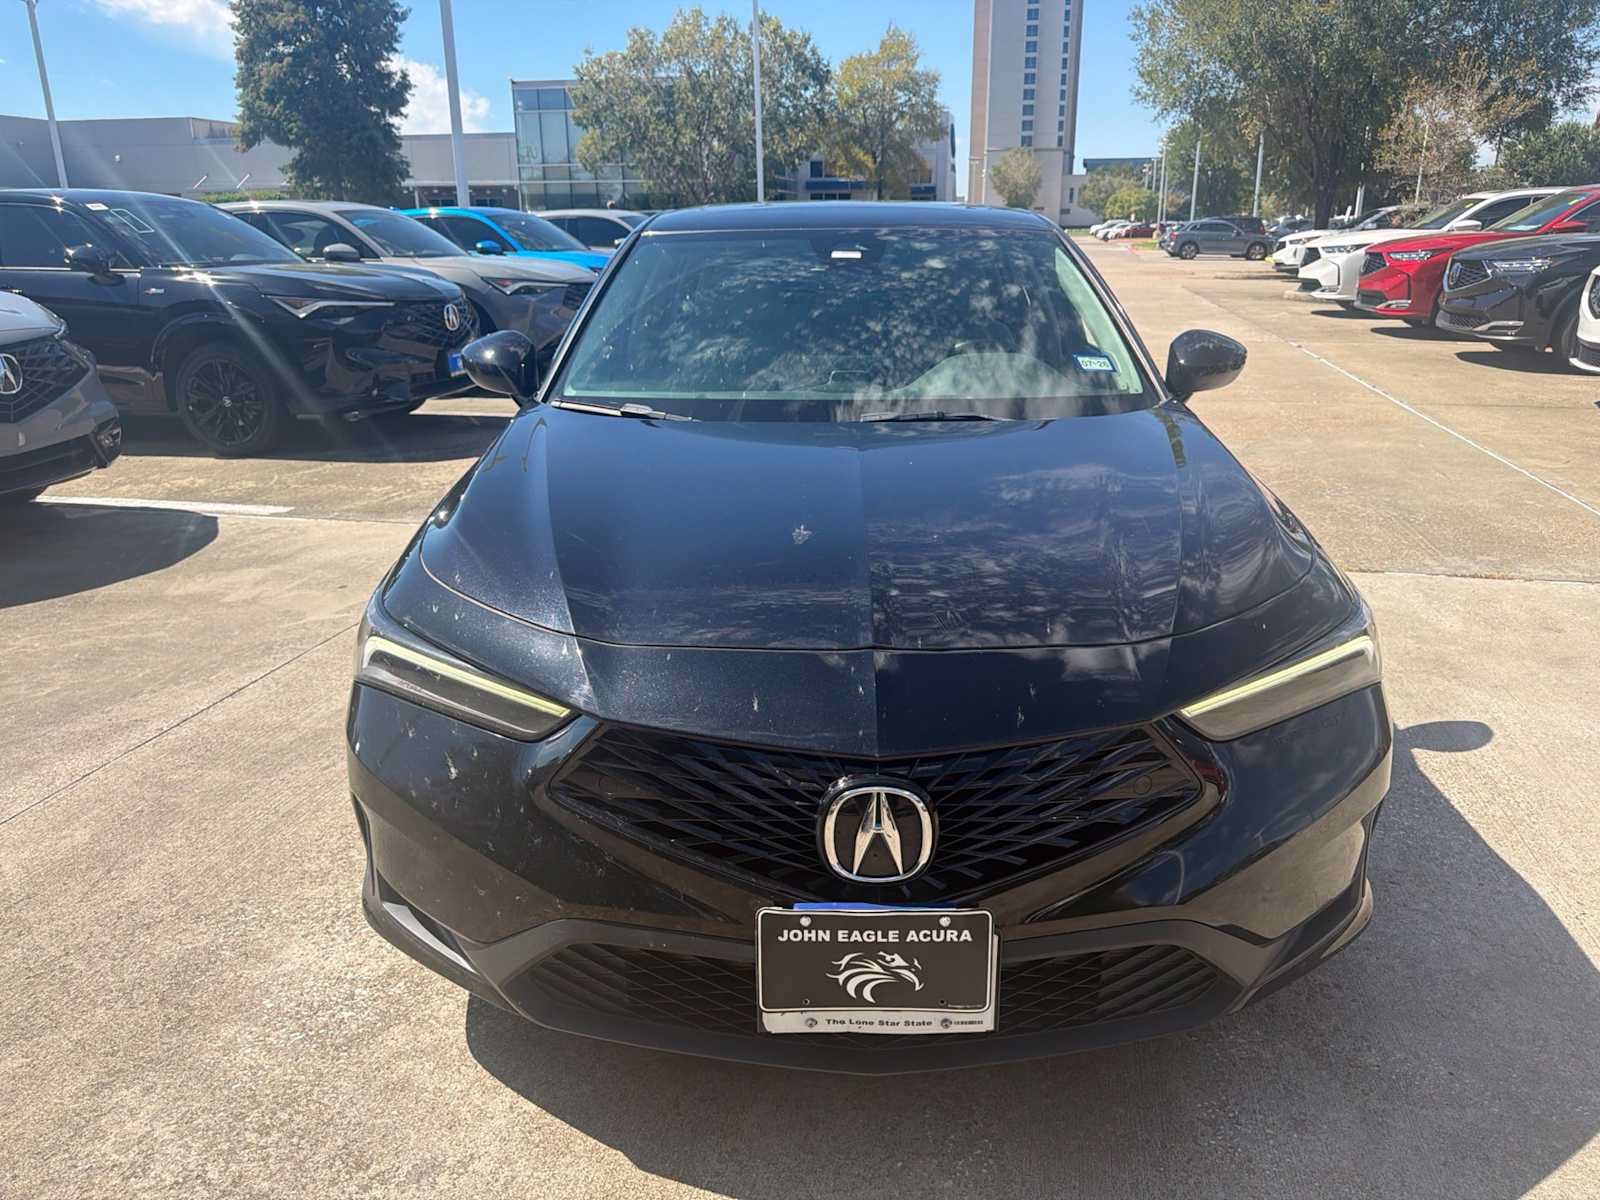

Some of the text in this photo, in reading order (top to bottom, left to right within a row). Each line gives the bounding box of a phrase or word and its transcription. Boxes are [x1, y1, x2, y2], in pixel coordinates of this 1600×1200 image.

[778, 929, 972, 942] JOHN EAGLE ACURA
[826, 1018, 933, 1027] The Lone Star State
